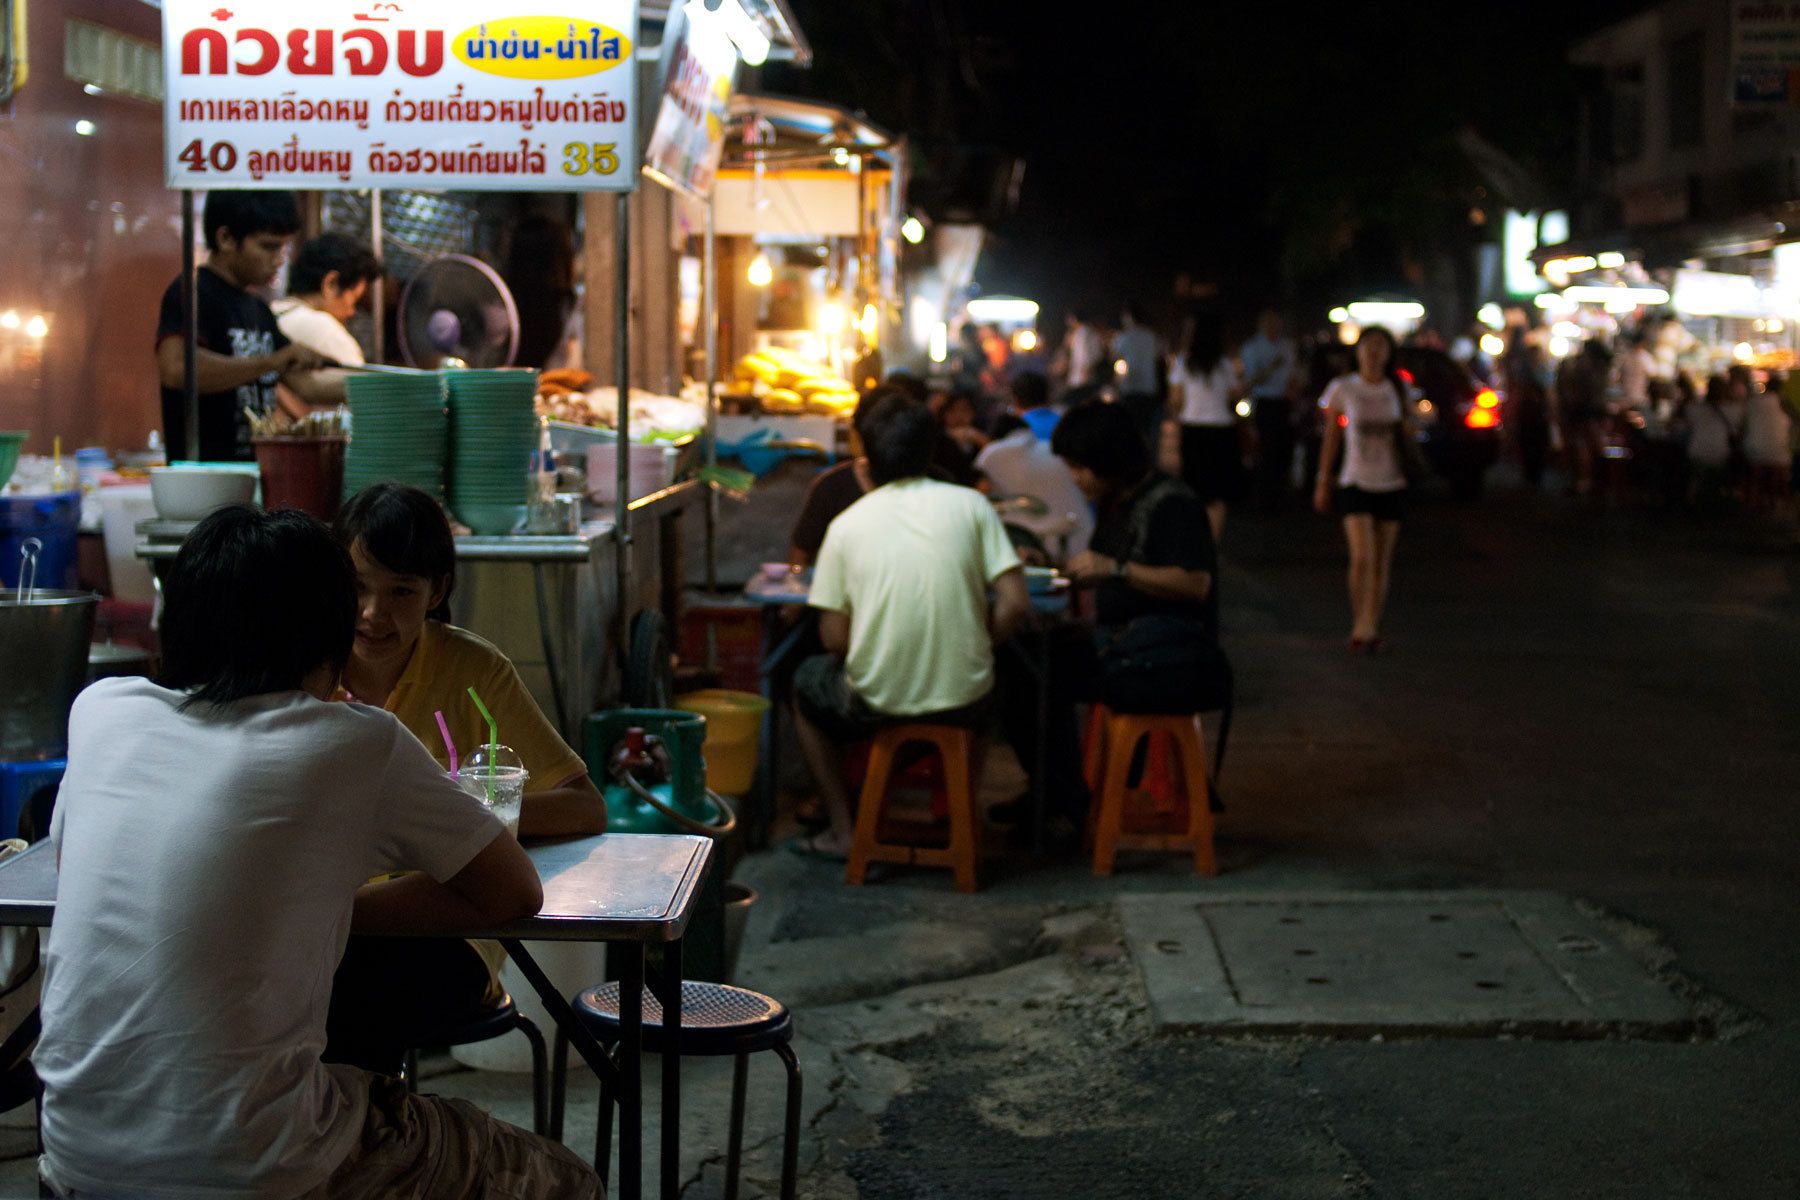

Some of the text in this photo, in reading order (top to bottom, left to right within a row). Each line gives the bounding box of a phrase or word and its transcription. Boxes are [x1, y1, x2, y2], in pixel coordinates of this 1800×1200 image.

[181, 3, 445, 77] ก๋วยจั๊บ
[180, 90, 369, 129] เกาเหลาเลือดหมู
[178, 138, 238, 172] 40
[247, 134, 352, 181] ลูกชิ้นหมู
[562, 141, 619, 176] 35
